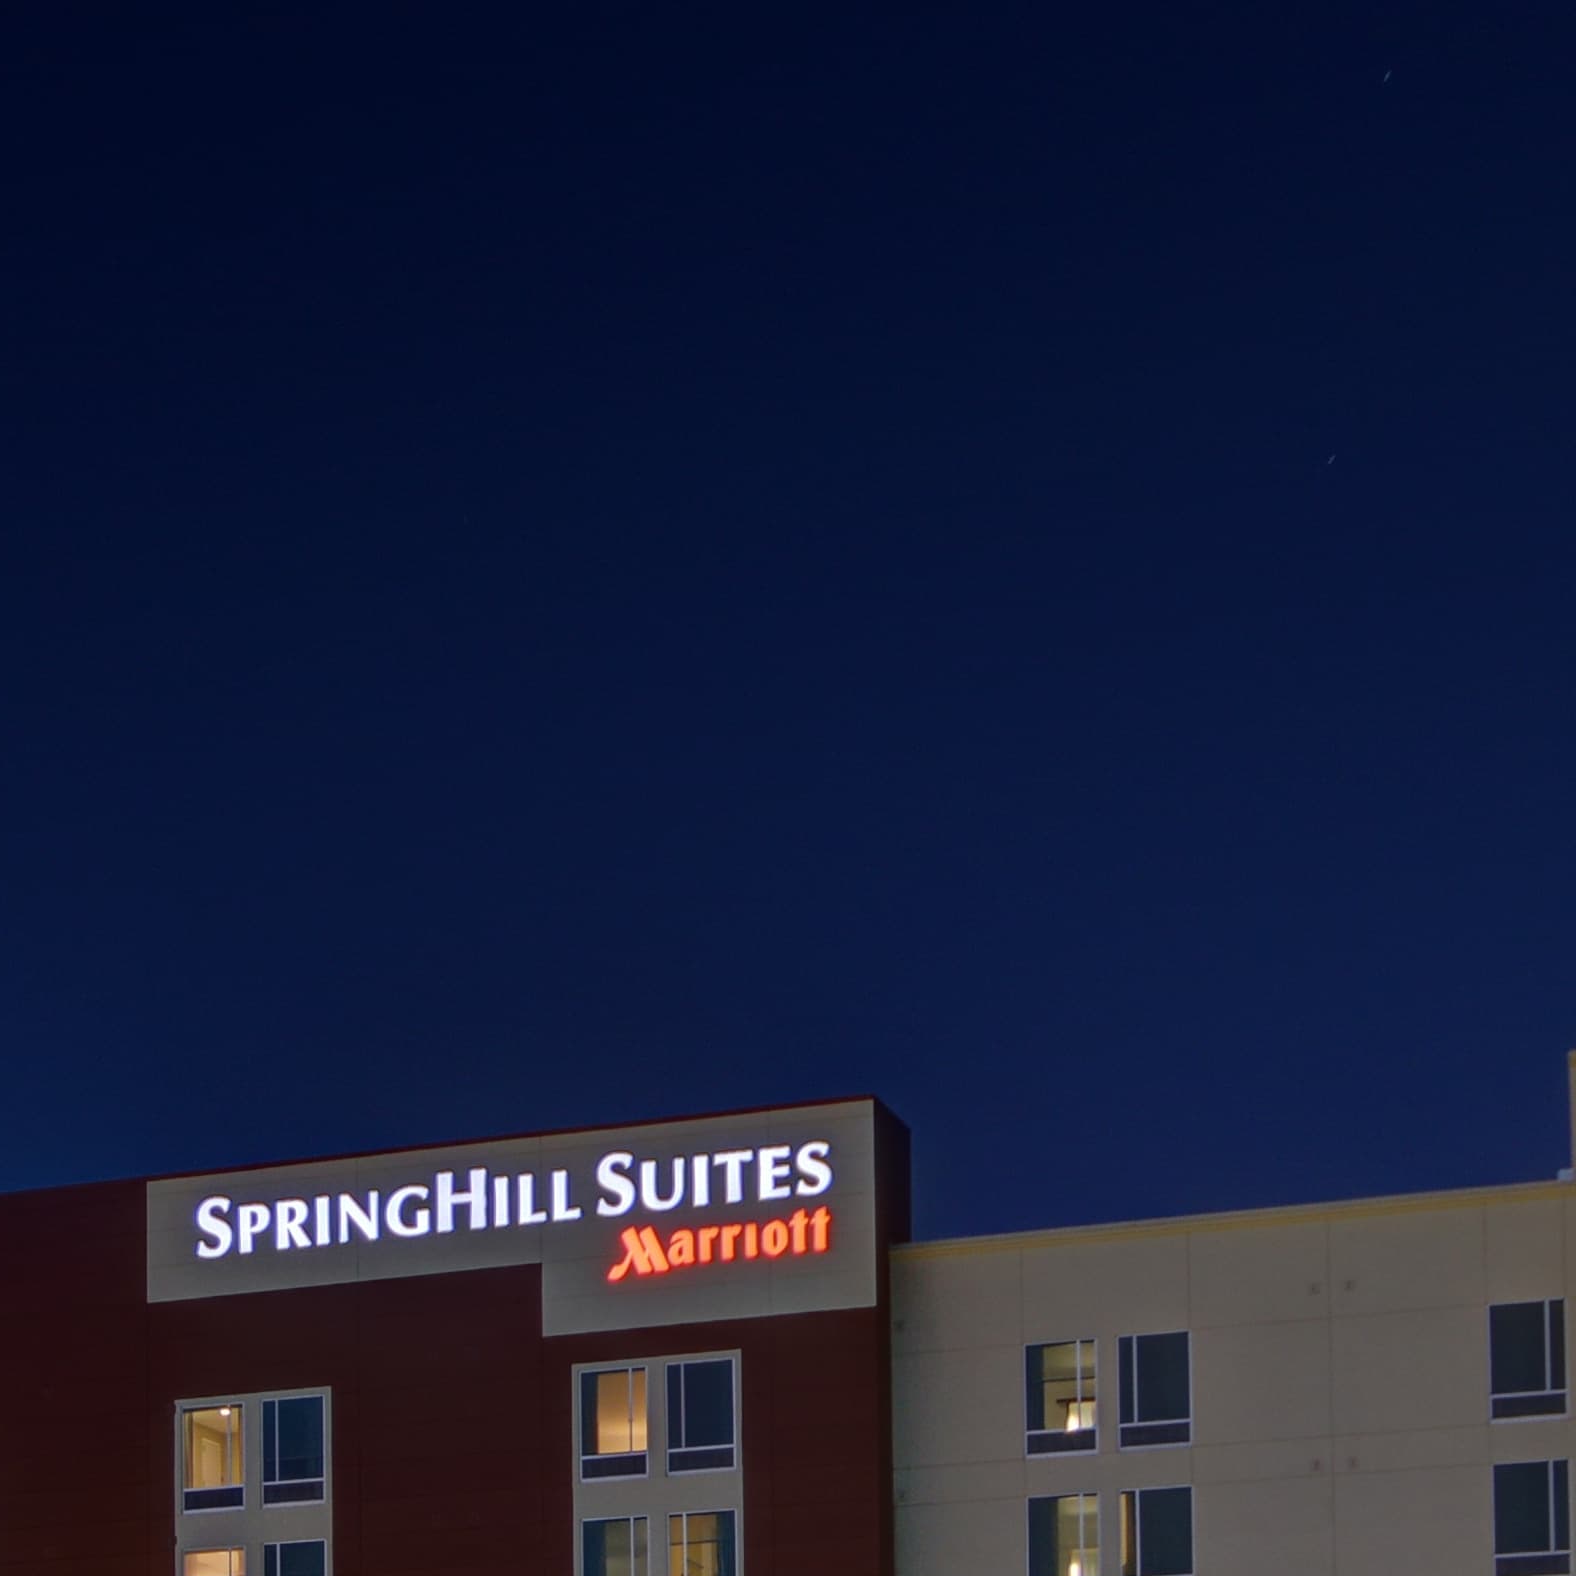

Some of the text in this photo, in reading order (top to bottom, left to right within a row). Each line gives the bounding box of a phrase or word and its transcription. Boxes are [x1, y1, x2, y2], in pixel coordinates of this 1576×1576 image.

[196, 1141, 833, 1259] SPRINGHILL SUITES
[607, 1206, 832, 1282] Marriott
